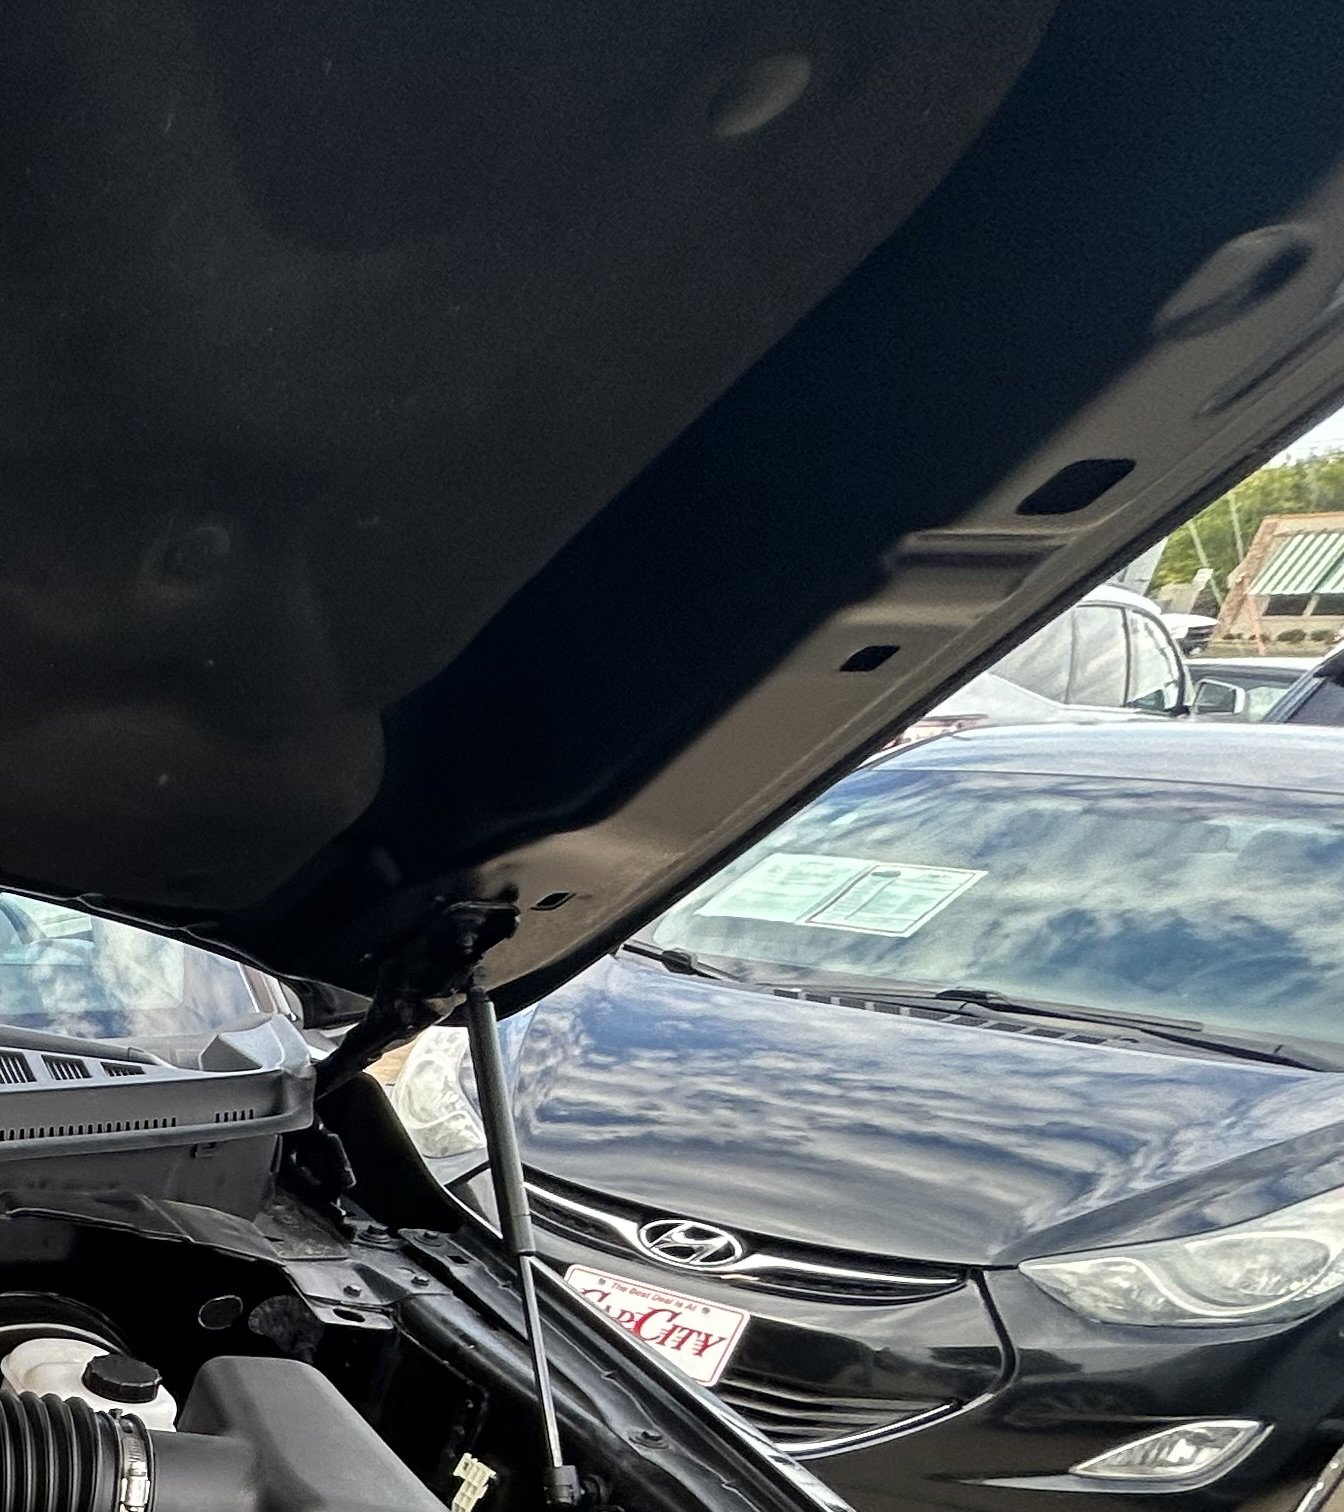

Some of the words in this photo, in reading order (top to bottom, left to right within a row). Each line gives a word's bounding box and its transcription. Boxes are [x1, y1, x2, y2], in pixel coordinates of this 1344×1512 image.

[612, 1282, 629, 1294] The
[629, 1286, 650, 1300] Best
[651, 1292, 674, 1305] Deal
